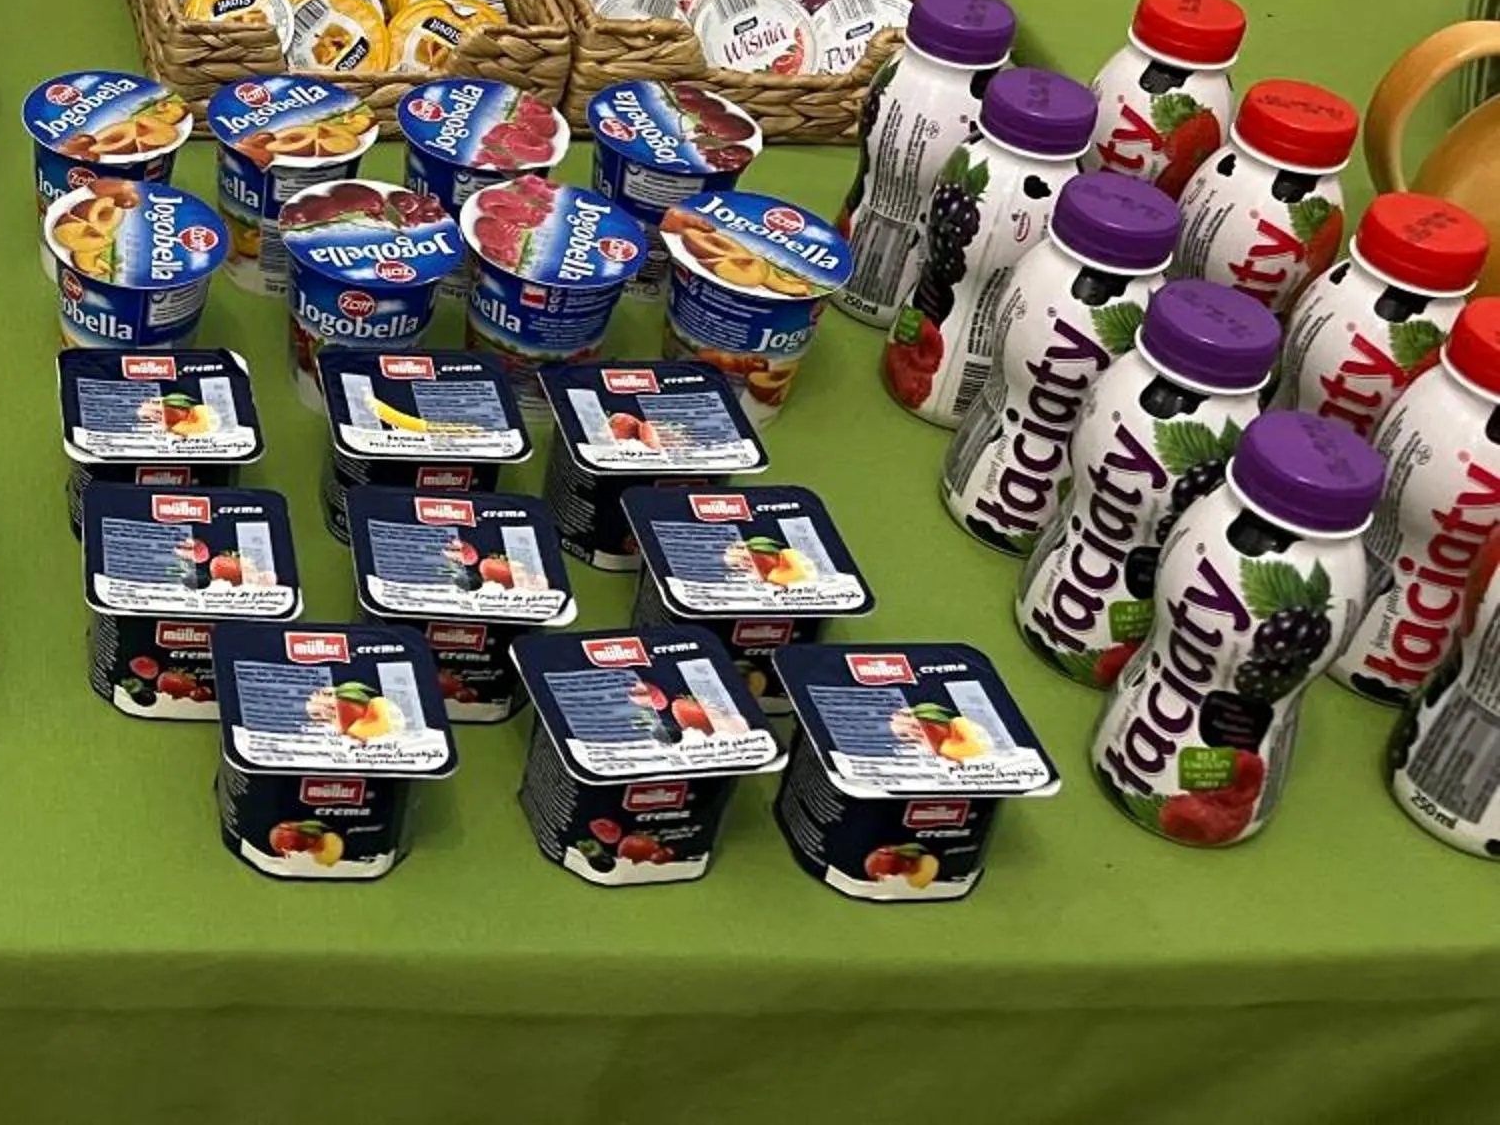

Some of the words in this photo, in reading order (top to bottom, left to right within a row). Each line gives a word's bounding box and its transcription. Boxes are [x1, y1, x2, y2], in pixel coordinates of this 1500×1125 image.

[34, 79, 139, 138] Jogobella
[216, 83, 329, 134] Jogobella
[424, 84, 485, 156] Jogobella
[612, 90, 691, 166] Jogobella
[144, 192, 184, 281] Jogobella
[307, 232, 456, 267] Jogobella
[558, 197, 612, 281] Jogobella
[694, 196, 840, 270] Jogobella
[298, 291, 419, 338] Jogobella
[217, 505, 264, 515] crema
[169, 650, 213, 660] crem
[292, 638, 342, 656] müller
[356, 644, 406, 654] crema
[919, 663, 969, 675] crema
[1105, 557, 1251, 796] łaciaty
[313, 807, 372, 816] crema
[635, 810, 691, 822] crema
[914, 828, 972, 839] crema
